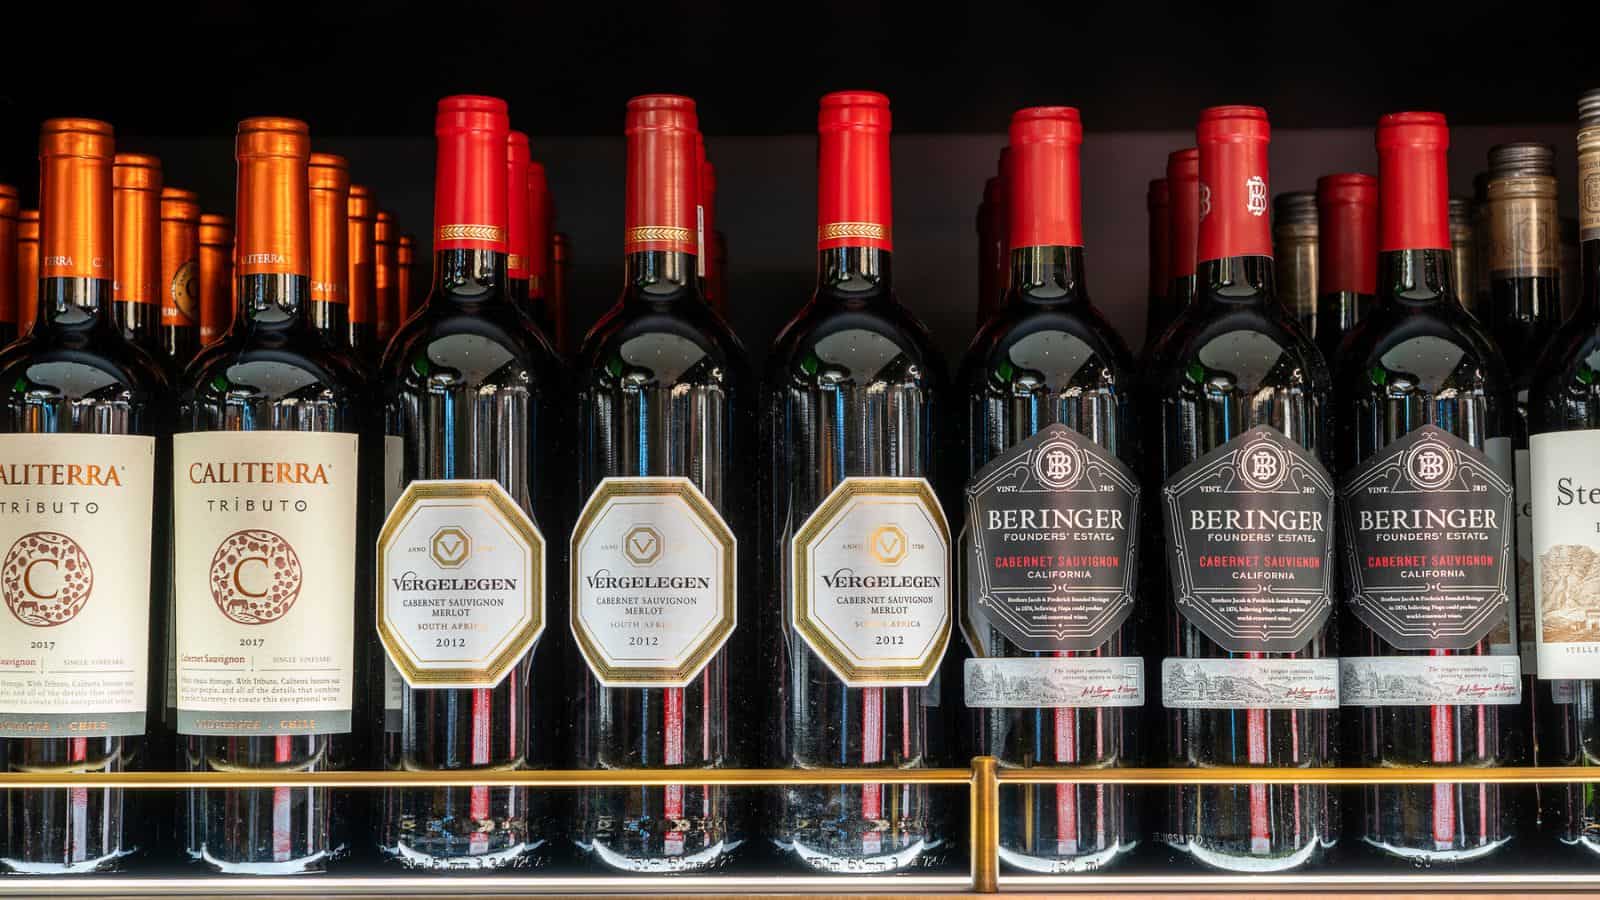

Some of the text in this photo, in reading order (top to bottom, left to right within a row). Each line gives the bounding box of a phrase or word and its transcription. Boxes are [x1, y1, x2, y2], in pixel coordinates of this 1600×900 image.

[189, 462, 329, 484] CALITERRA
[987, 508, 1125, 530] BERINGER
[1190, 510, 1324, 531] BERINGER
[1360, 508, 1498, 531] BERINGER
[995, 555, 1119, 568] CABERNET SAUVIGNON
[1199, 555, 1320, 568] CABERNET SAUVIGNON
[1367, 555, 1493, 568] CABERNET SAUVIGNON
[1027, 570, 1092, 579] CALIFORNIA
[1231, 571, 1296, 580] CALIFORNIA
[1400, 569, 1465, 578] CALIFORNIA
[402, 599, 505, 607] CABERNET SAUVIGNON
[596, 596, 697, 605] CABERNET SAUVIGNON
[836, 596, 934, 605] CABERNET SAUVIGNON
[431, 608, 471, 617] MERLOT
[624, 607, 664, 615] MERLOT
[871, 606, 908, 614] MERLOT
[239, 638, 265, 647] 2017
[435, 638, 466, 648] 2012
[629, 636, 659, 646] 2012
[875, 636, 905, 645] 2012
[30, 641, 56, 650] 2017
